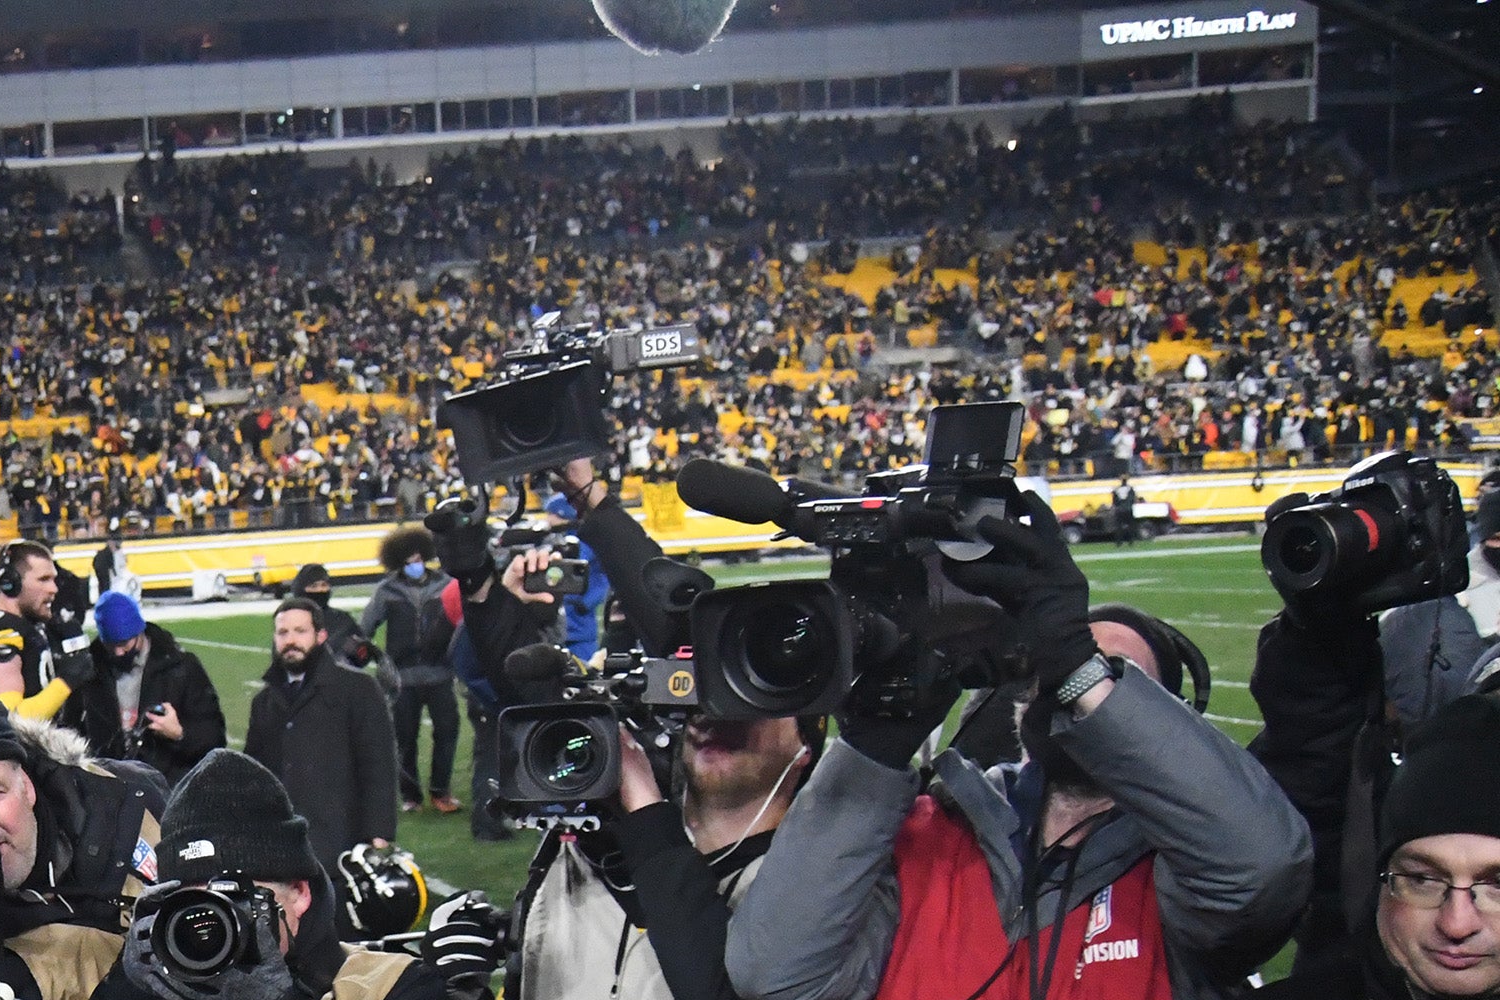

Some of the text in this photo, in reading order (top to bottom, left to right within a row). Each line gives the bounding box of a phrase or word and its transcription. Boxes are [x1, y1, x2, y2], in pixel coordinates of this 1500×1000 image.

[1100, 19, 1171, 45] UPMC
[645, 336, 677, 353] SDS
[814, 505, 843, 513] SONY
